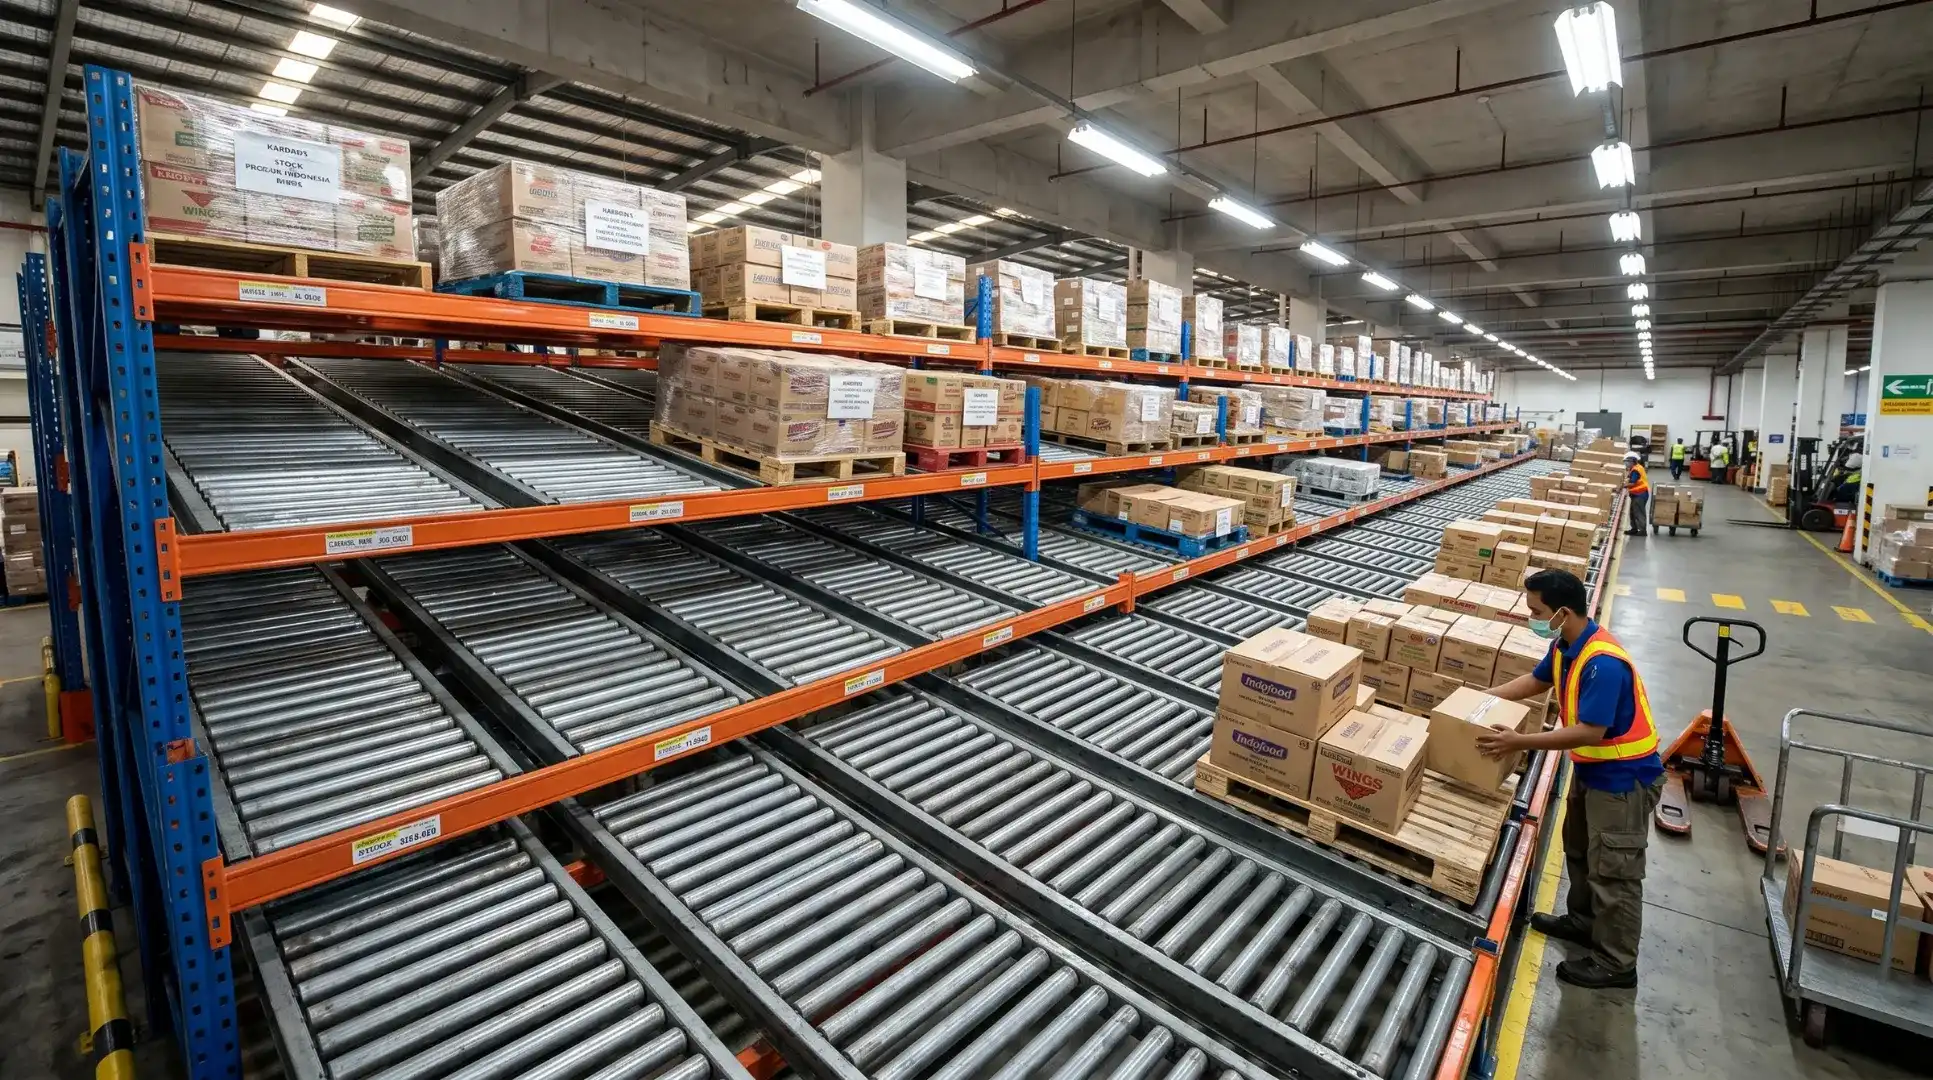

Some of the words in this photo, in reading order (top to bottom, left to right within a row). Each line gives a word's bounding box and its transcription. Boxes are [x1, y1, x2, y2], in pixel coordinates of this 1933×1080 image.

[274, 159, 304, 170] STOCK
[1244, 674, 1292, 700] Indofood
[1236, 733, 1284, 757] Indofood
[1331, 762, 1383, 791] WINGS
